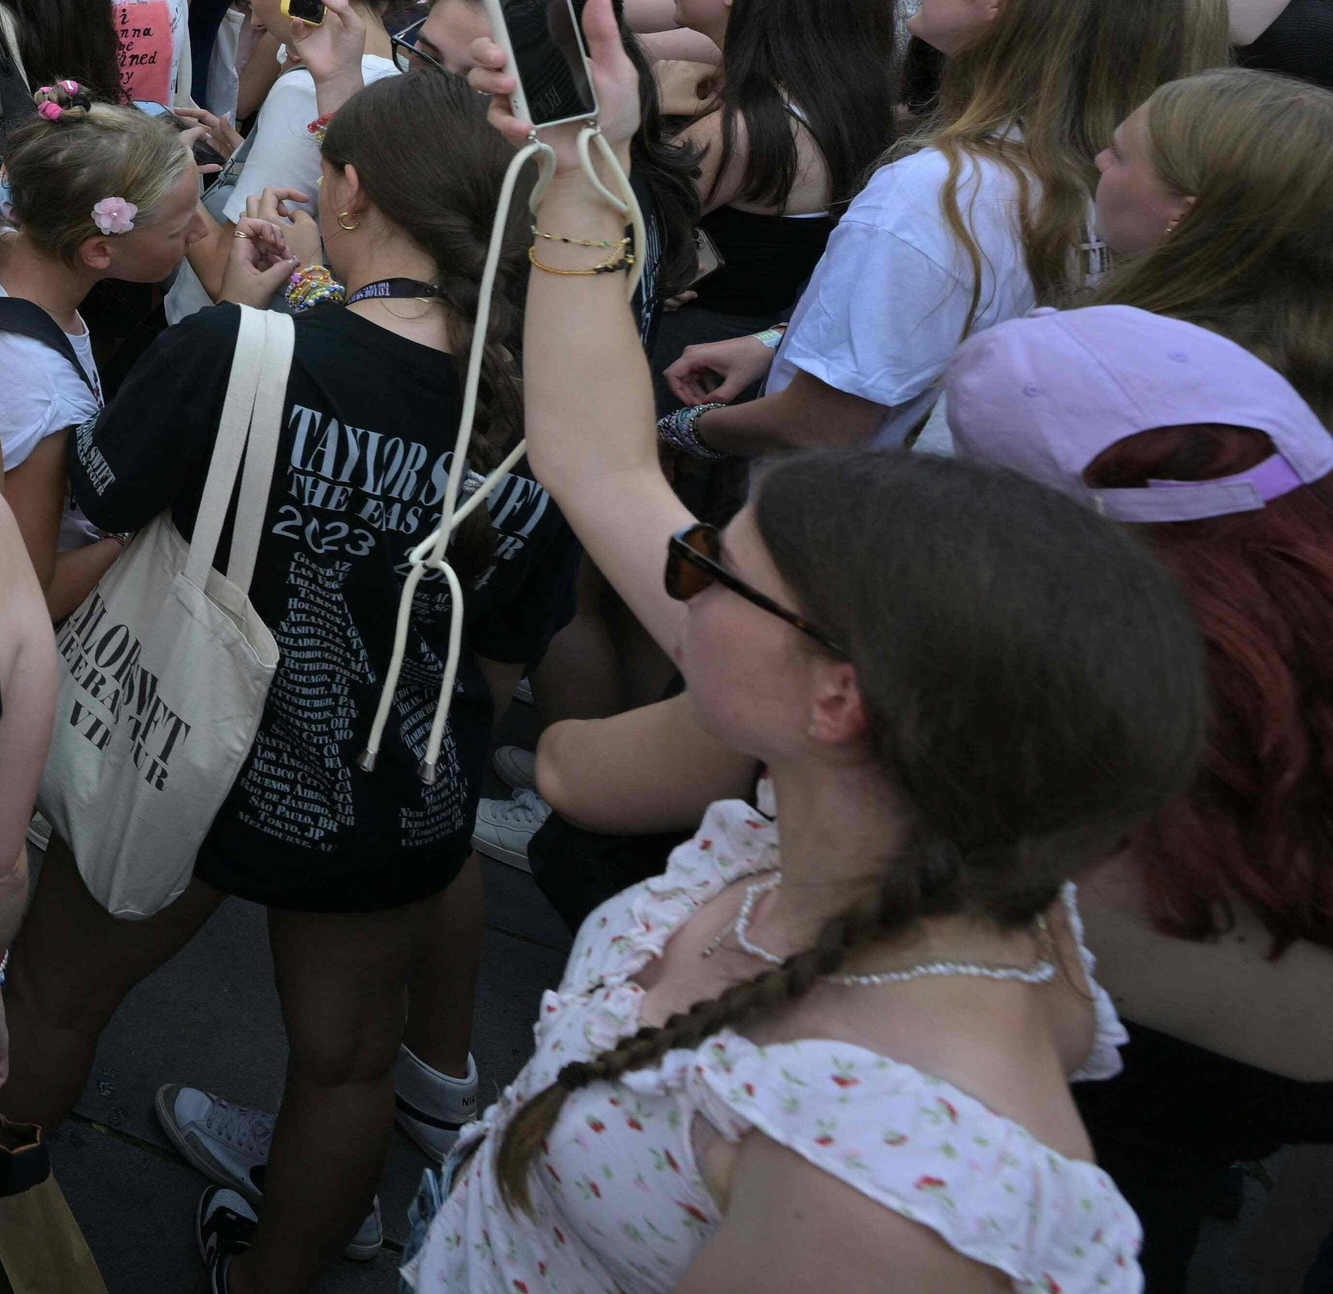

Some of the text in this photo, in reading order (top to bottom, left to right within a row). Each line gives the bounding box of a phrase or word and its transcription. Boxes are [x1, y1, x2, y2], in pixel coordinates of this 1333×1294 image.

[119, 26, 154, 39] nna
[287, 404, 428, 502] TAYLOR
[287, 465, 354, 512] THE
[61, 593, 142, 684] YLOR
[278, 646, 345, 665] XBOROUGH,
[270, 686, 335, 708] ITTSBURGH,
[403, 719, 434, 749] HAMBURG
[253, 758, 295, 780] MEXICO
[247, 769, 291, 793] BUENOS
[304, 826, 325, 841] JP
[461, 1094, 476, 1107] NIK
